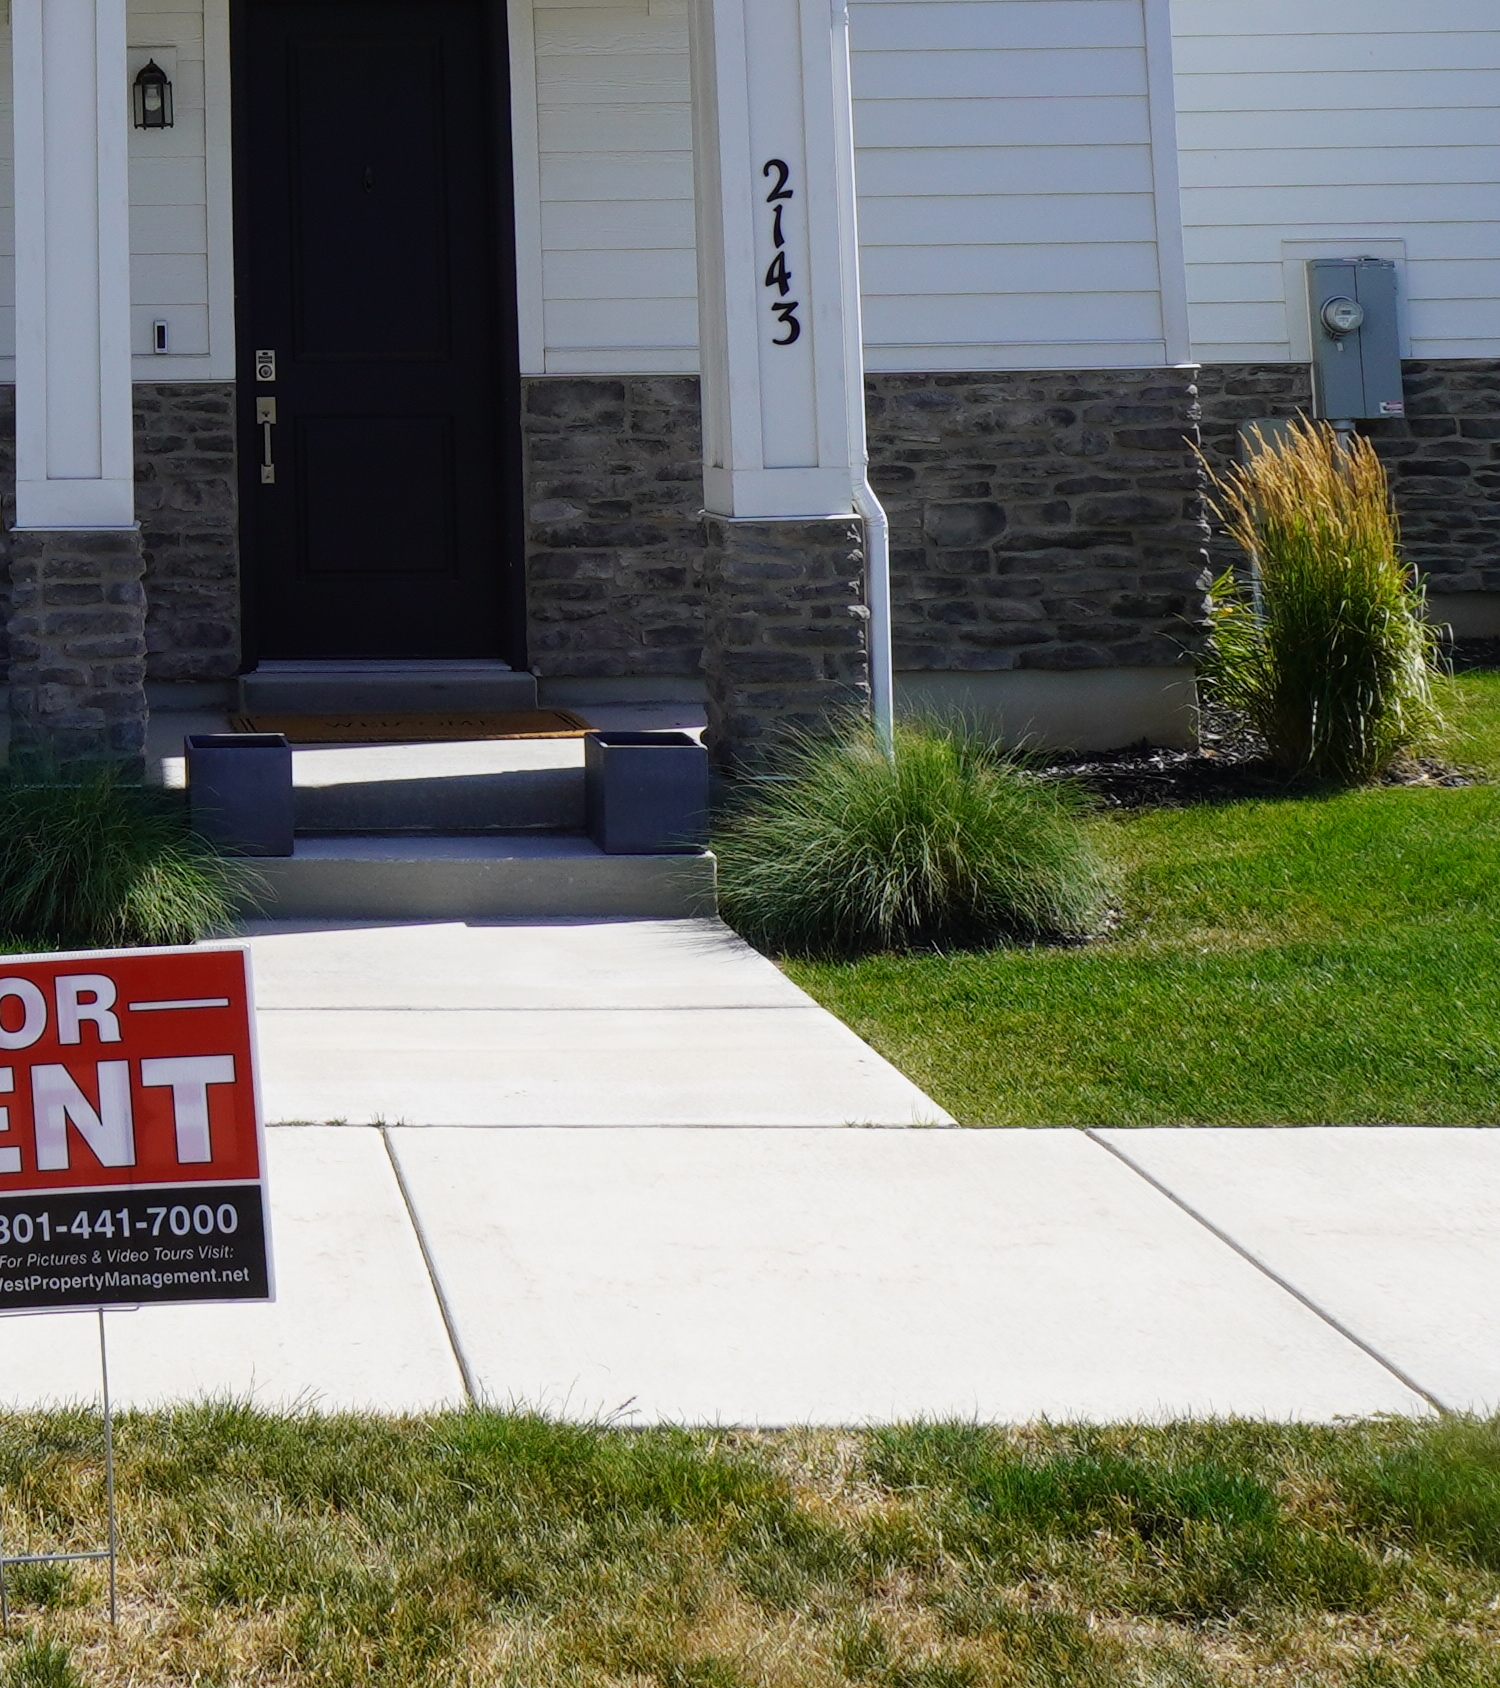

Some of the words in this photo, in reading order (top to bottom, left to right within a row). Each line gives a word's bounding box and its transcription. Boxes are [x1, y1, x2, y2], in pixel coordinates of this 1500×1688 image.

[763, 158, 800, 346] 2143
[27, 1250, 88, 1267] Pictures
[91, 1251, 103, 1264] &
[107, 1248, 149, 1263] Video
[154, 1247, 194, 1261] Tours
[198, 1245, 234, 1259] Visit:
